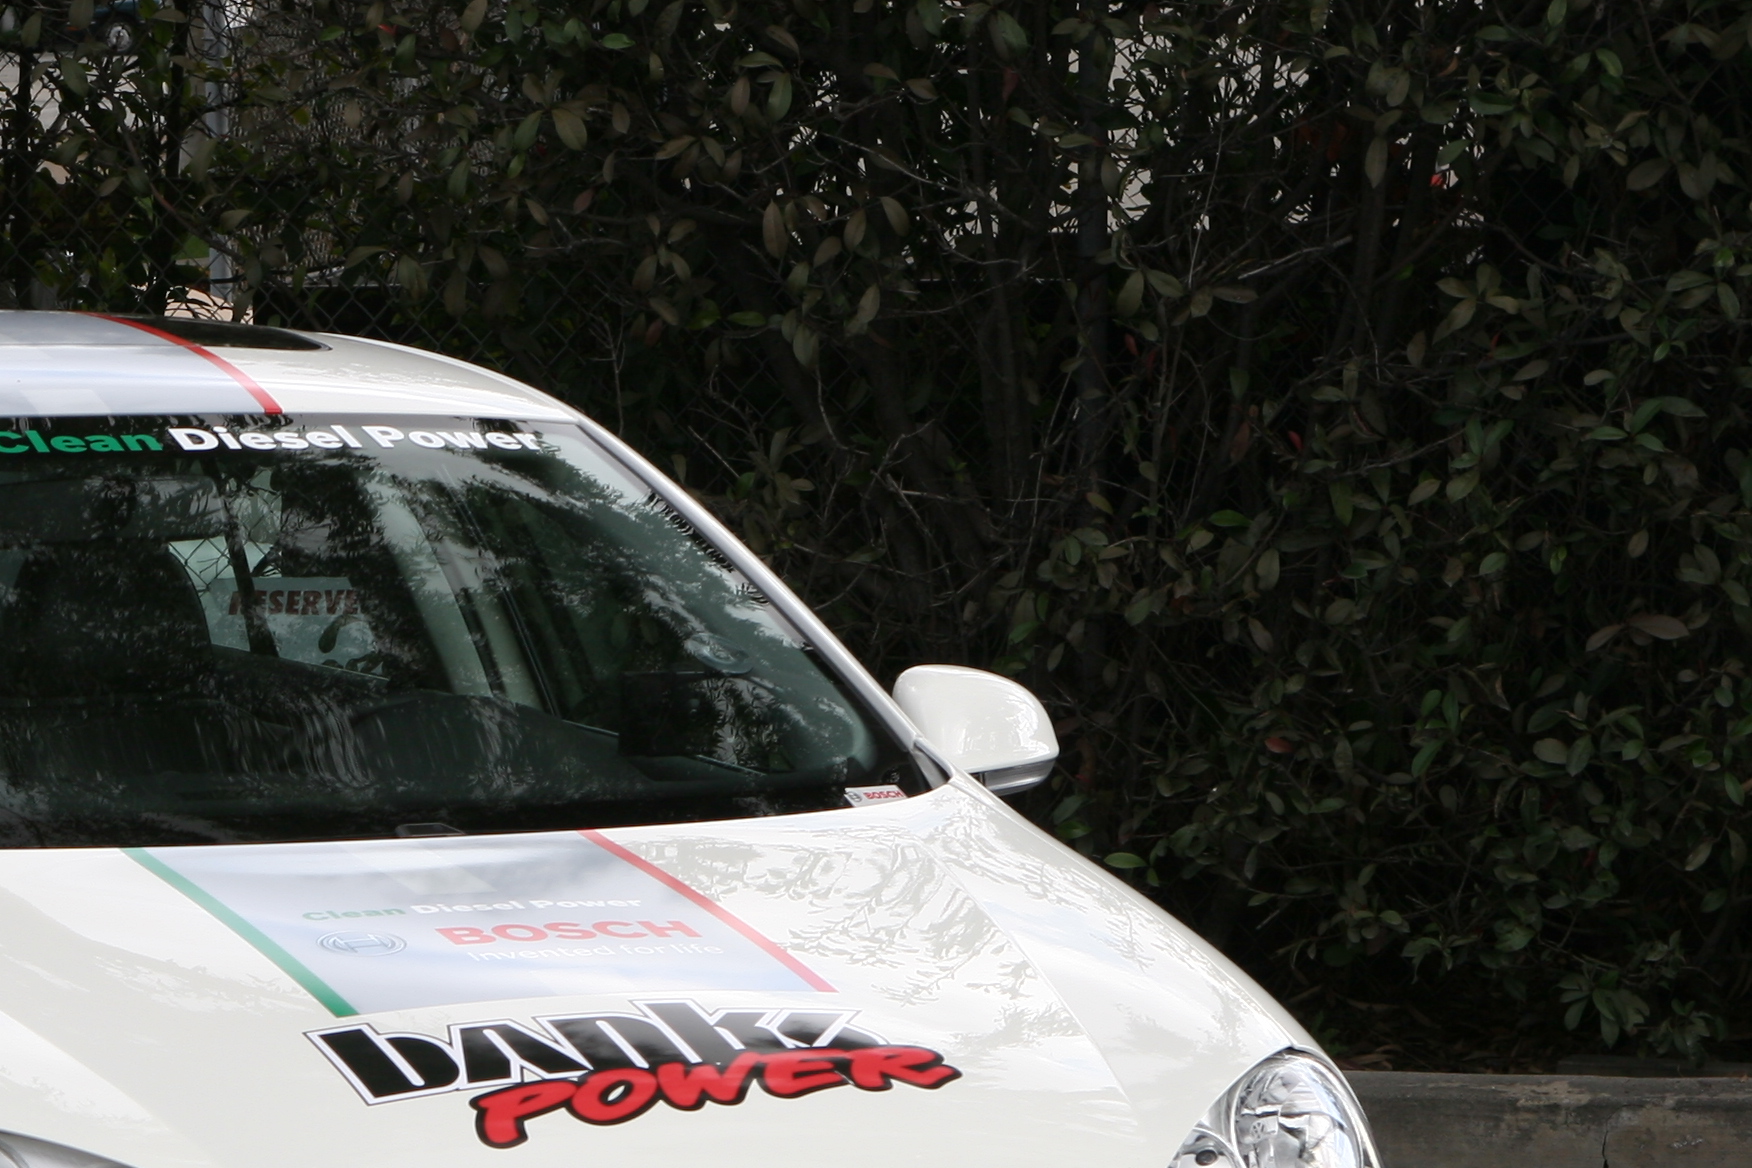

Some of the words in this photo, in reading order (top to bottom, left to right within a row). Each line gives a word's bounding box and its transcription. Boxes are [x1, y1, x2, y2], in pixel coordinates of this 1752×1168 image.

[168, 424, 363, 452] Diesel
[361, 425, 543, 451] Power
[863, 790, 905, 800] BOSCH
[302, 907, 407, 922] Clean
[409, 900, 525, 916] Diesel
[528, 898, 642, 910] Power
[434, 920, 703, 946] BOSCH
[467, 944, 615, 962] Invented
[619, 944, 665, 956] for
[669, 942, 725, 955] life
[470, 1045, 962, 1149] POWER
